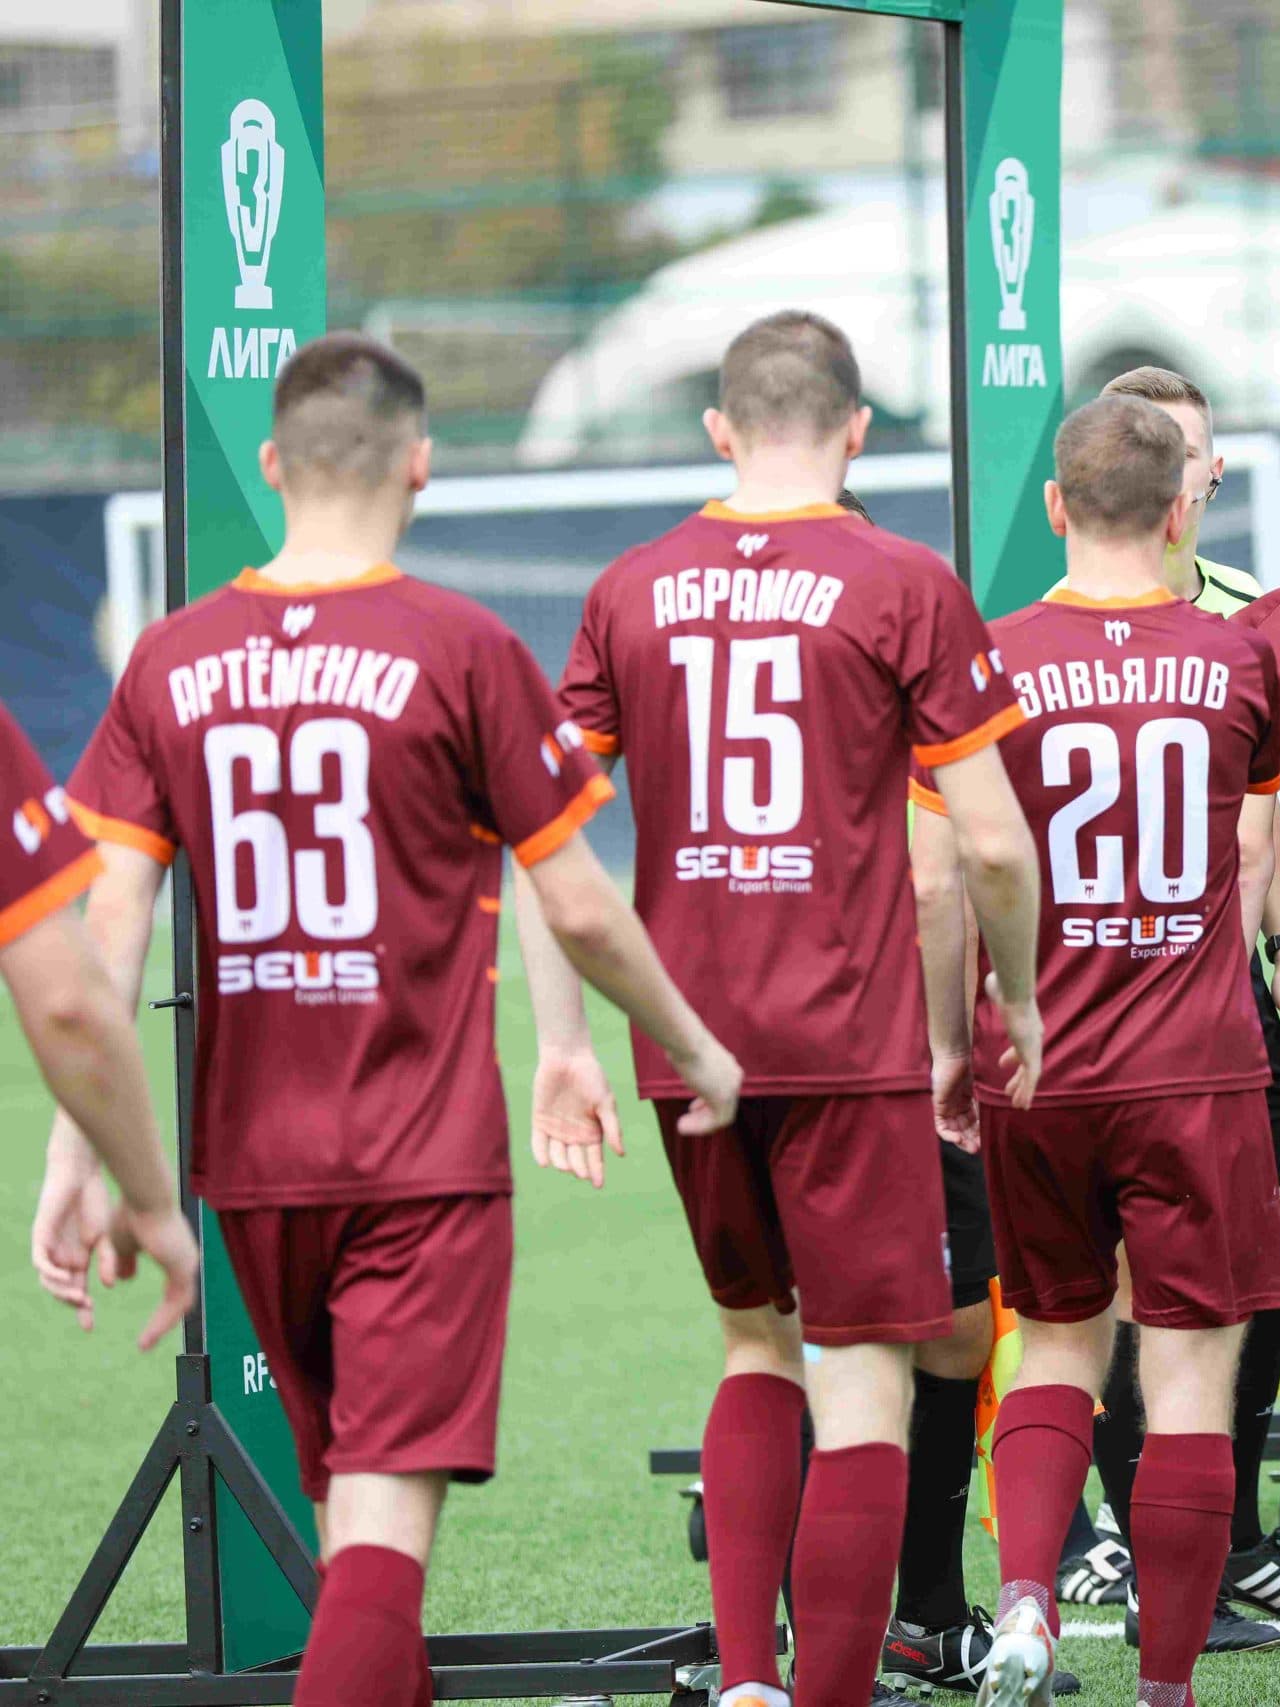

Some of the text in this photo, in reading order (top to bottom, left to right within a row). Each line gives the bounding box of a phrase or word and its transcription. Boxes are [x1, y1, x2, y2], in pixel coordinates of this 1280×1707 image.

[208, 327, 297, 379] ЛИГА
[982, 344, 1048, 388] ЛИГА
[653, 568, 844, 628] АБРАМОВ
[168, 635, 419, 727] АРТЁМЕНКО
[1013, 656, 1230, 719] ЗАВЬЯЛОВ
[669, 634, 804, 836] 15
[203, 717, 380, 943] 63
[1041, 717, 1211, 904] 20
[675, 845, 814, 880] SEUS
[728, 878, 812, 895] Export Union
[1062, 914, 1204, 947] SEUS
[1130, 946, 1167, 960] Export
[217, 950, 380, 994] SEUS
[243, 1351, 277, 1395] RF
